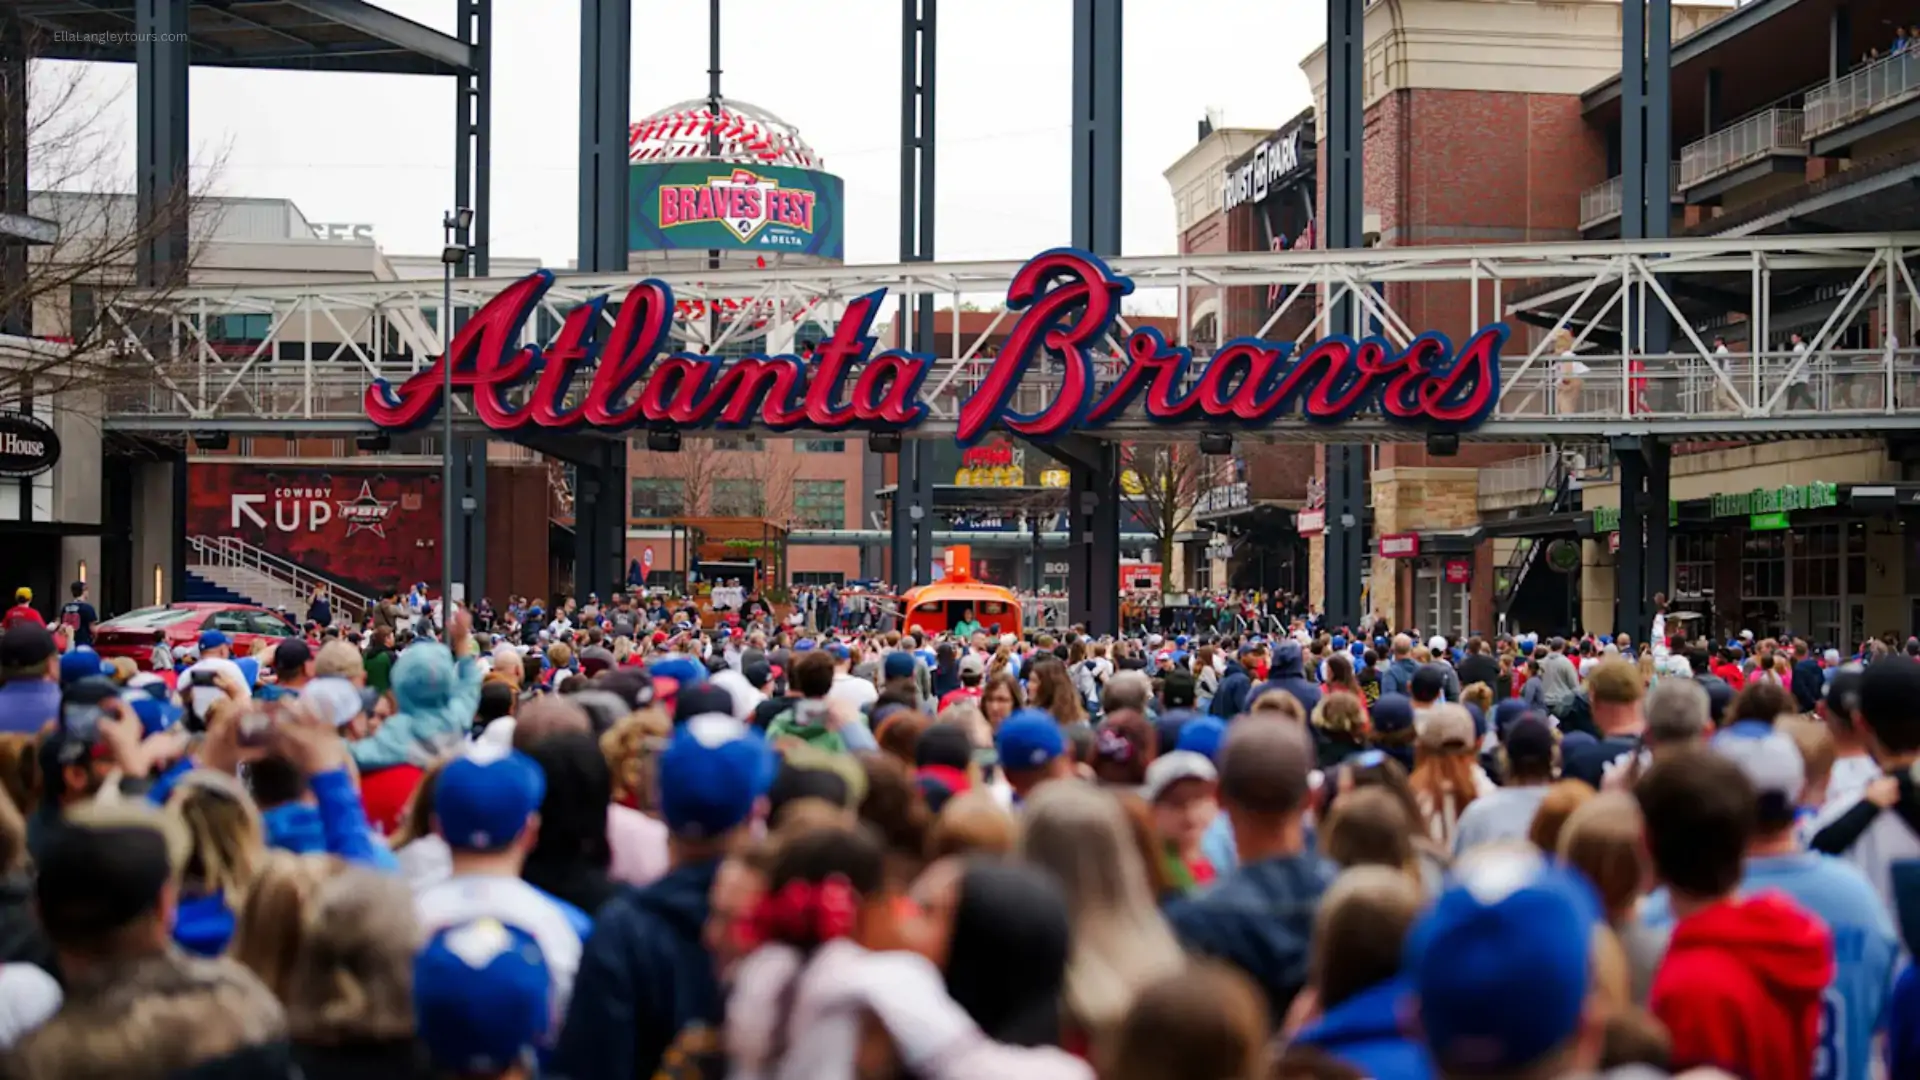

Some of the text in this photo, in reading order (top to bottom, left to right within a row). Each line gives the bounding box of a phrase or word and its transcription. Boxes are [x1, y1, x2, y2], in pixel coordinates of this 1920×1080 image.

[1268, 130, 1299, 184] PARK
[661, 186, 816, 230] BRAVES FEST
[770, 235, 803, 246] DELTA
[364, 247, 1511, 448] Atlanta Braves
[5, 432, 45, 457] House
[275, 487, 332, 499] COWBOY
[275, 500, 332, 532] UP
